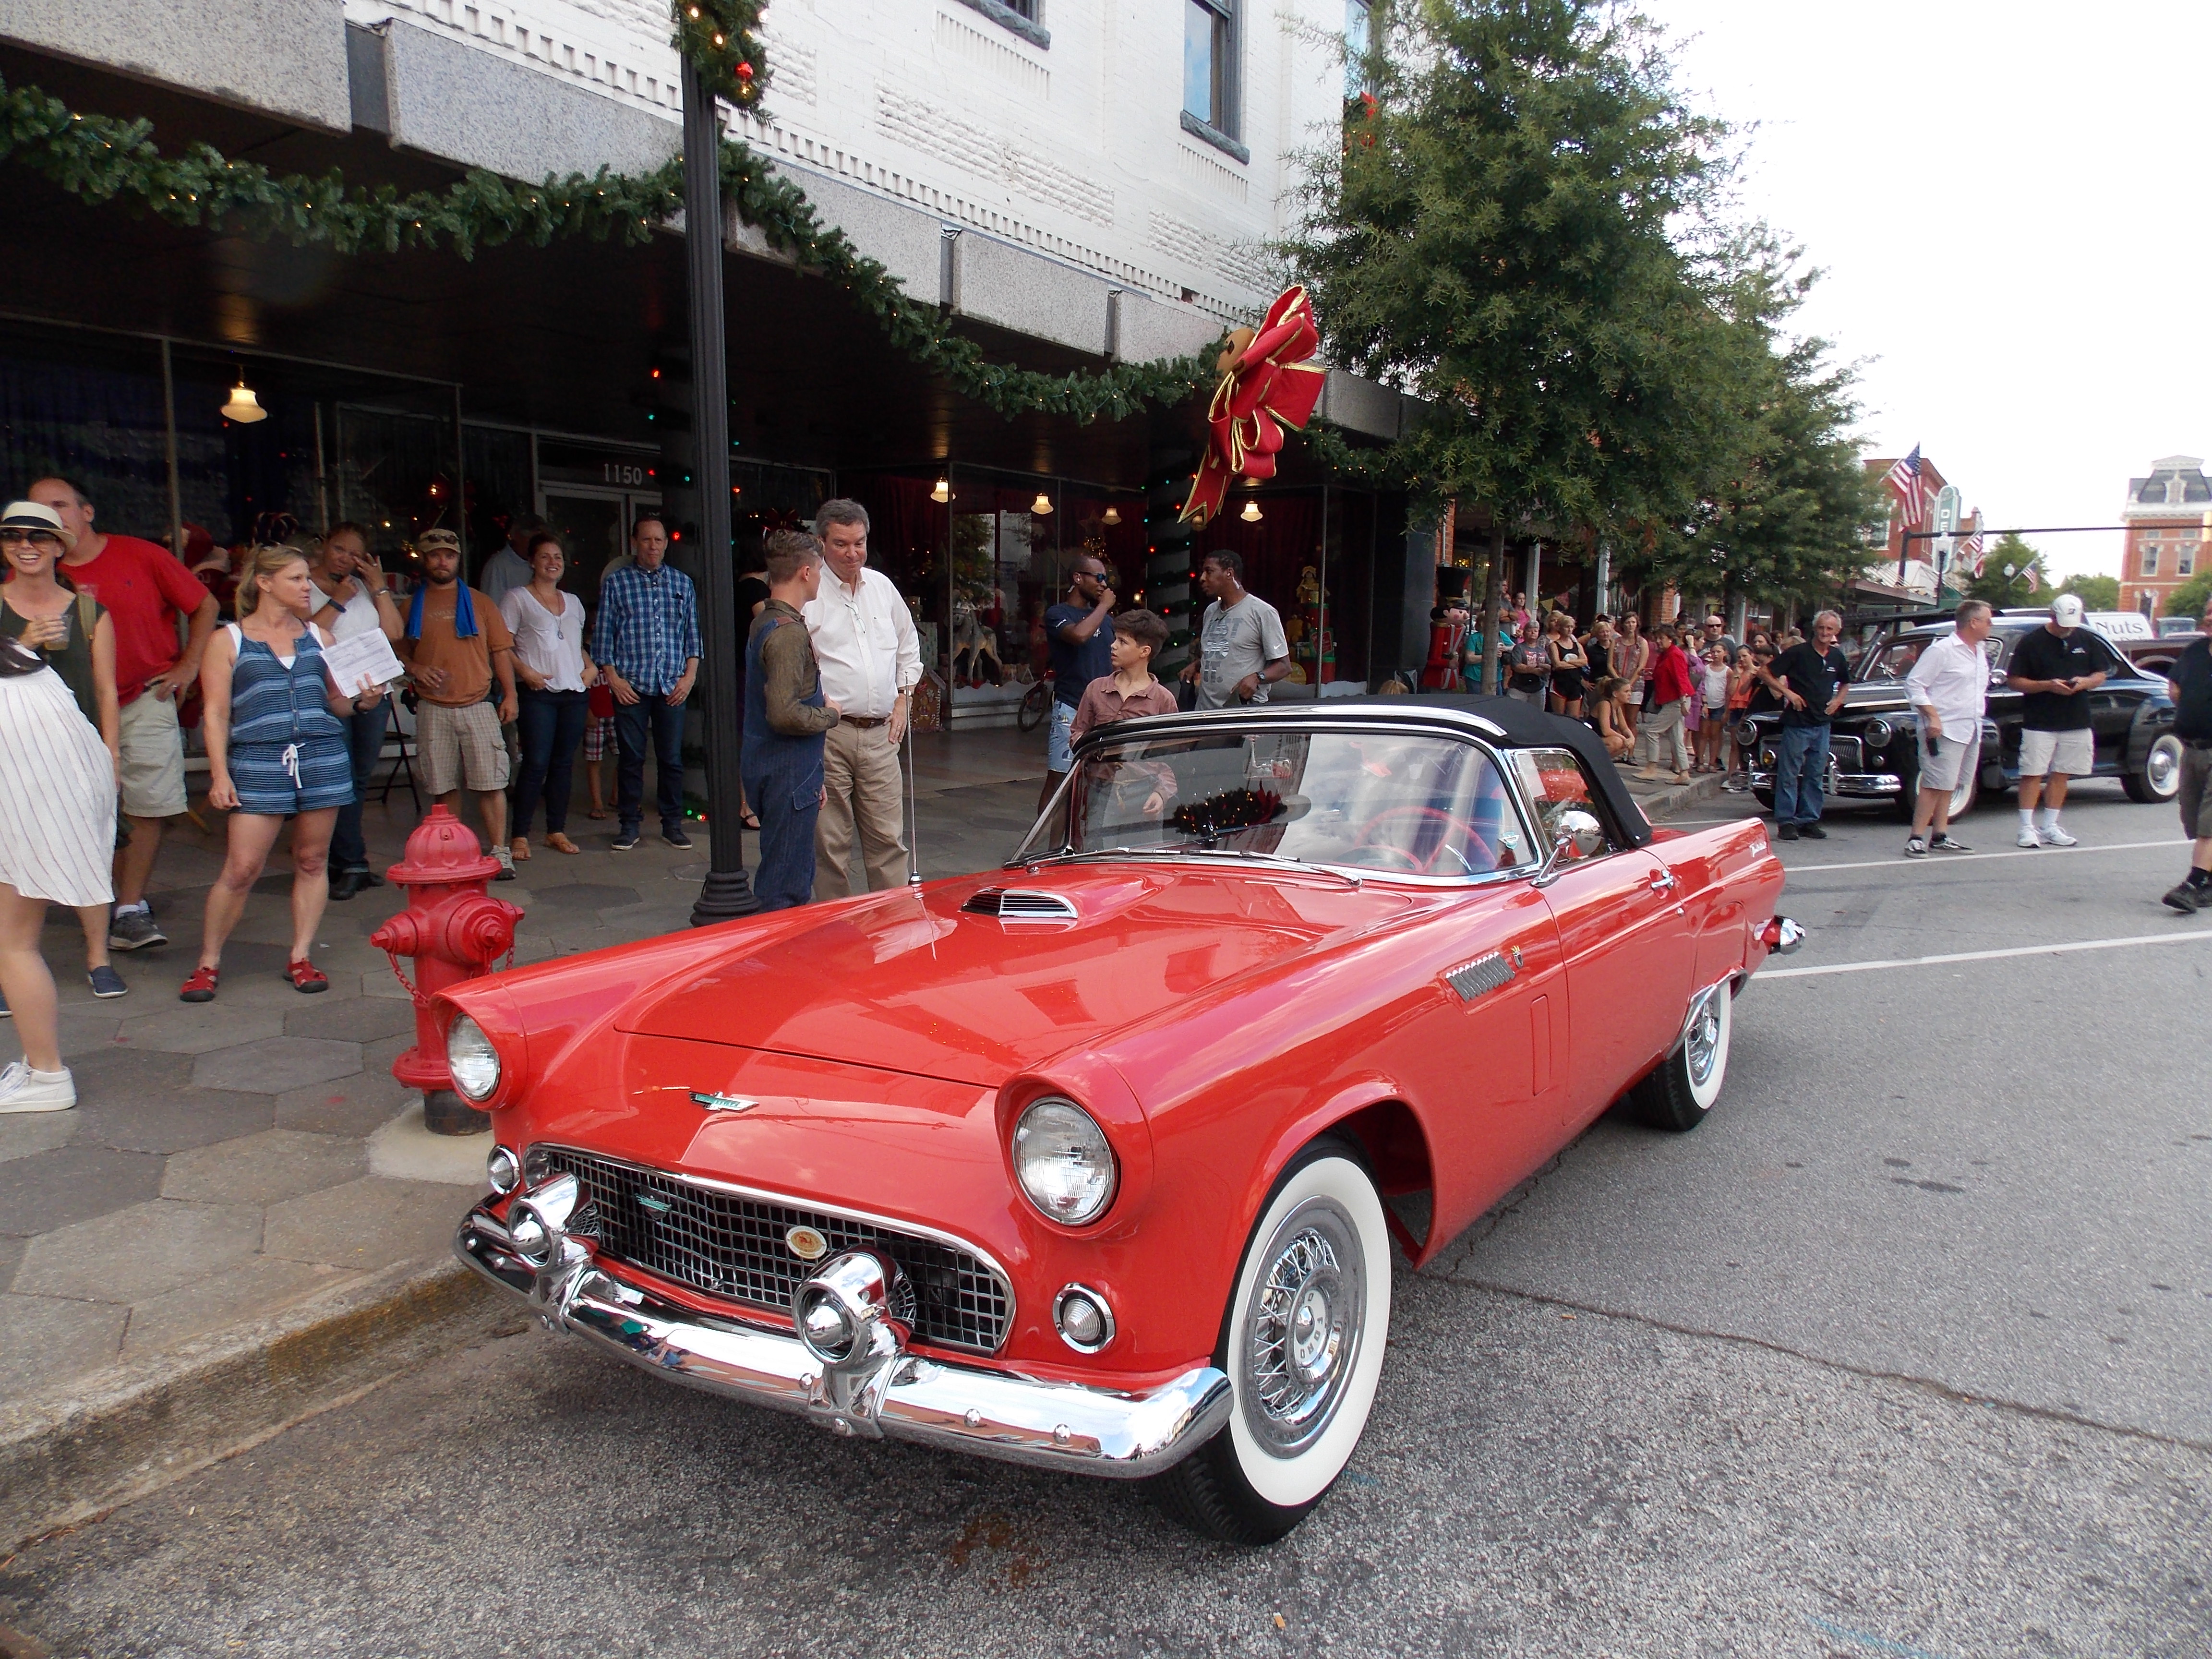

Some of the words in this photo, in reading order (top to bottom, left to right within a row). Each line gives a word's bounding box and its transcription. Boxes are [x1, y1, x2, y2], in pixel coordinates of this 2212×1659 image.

[604, 463, 642, 485] 1150
[1202, 617, 1244, 639] JUST
[2095, 621, 2143, 635] Nuts
[1204, 639, 1229, 660] DO
[1203, 661, 1224, 683] IT.
[1300, 1317, 1323, 1358] FORD
